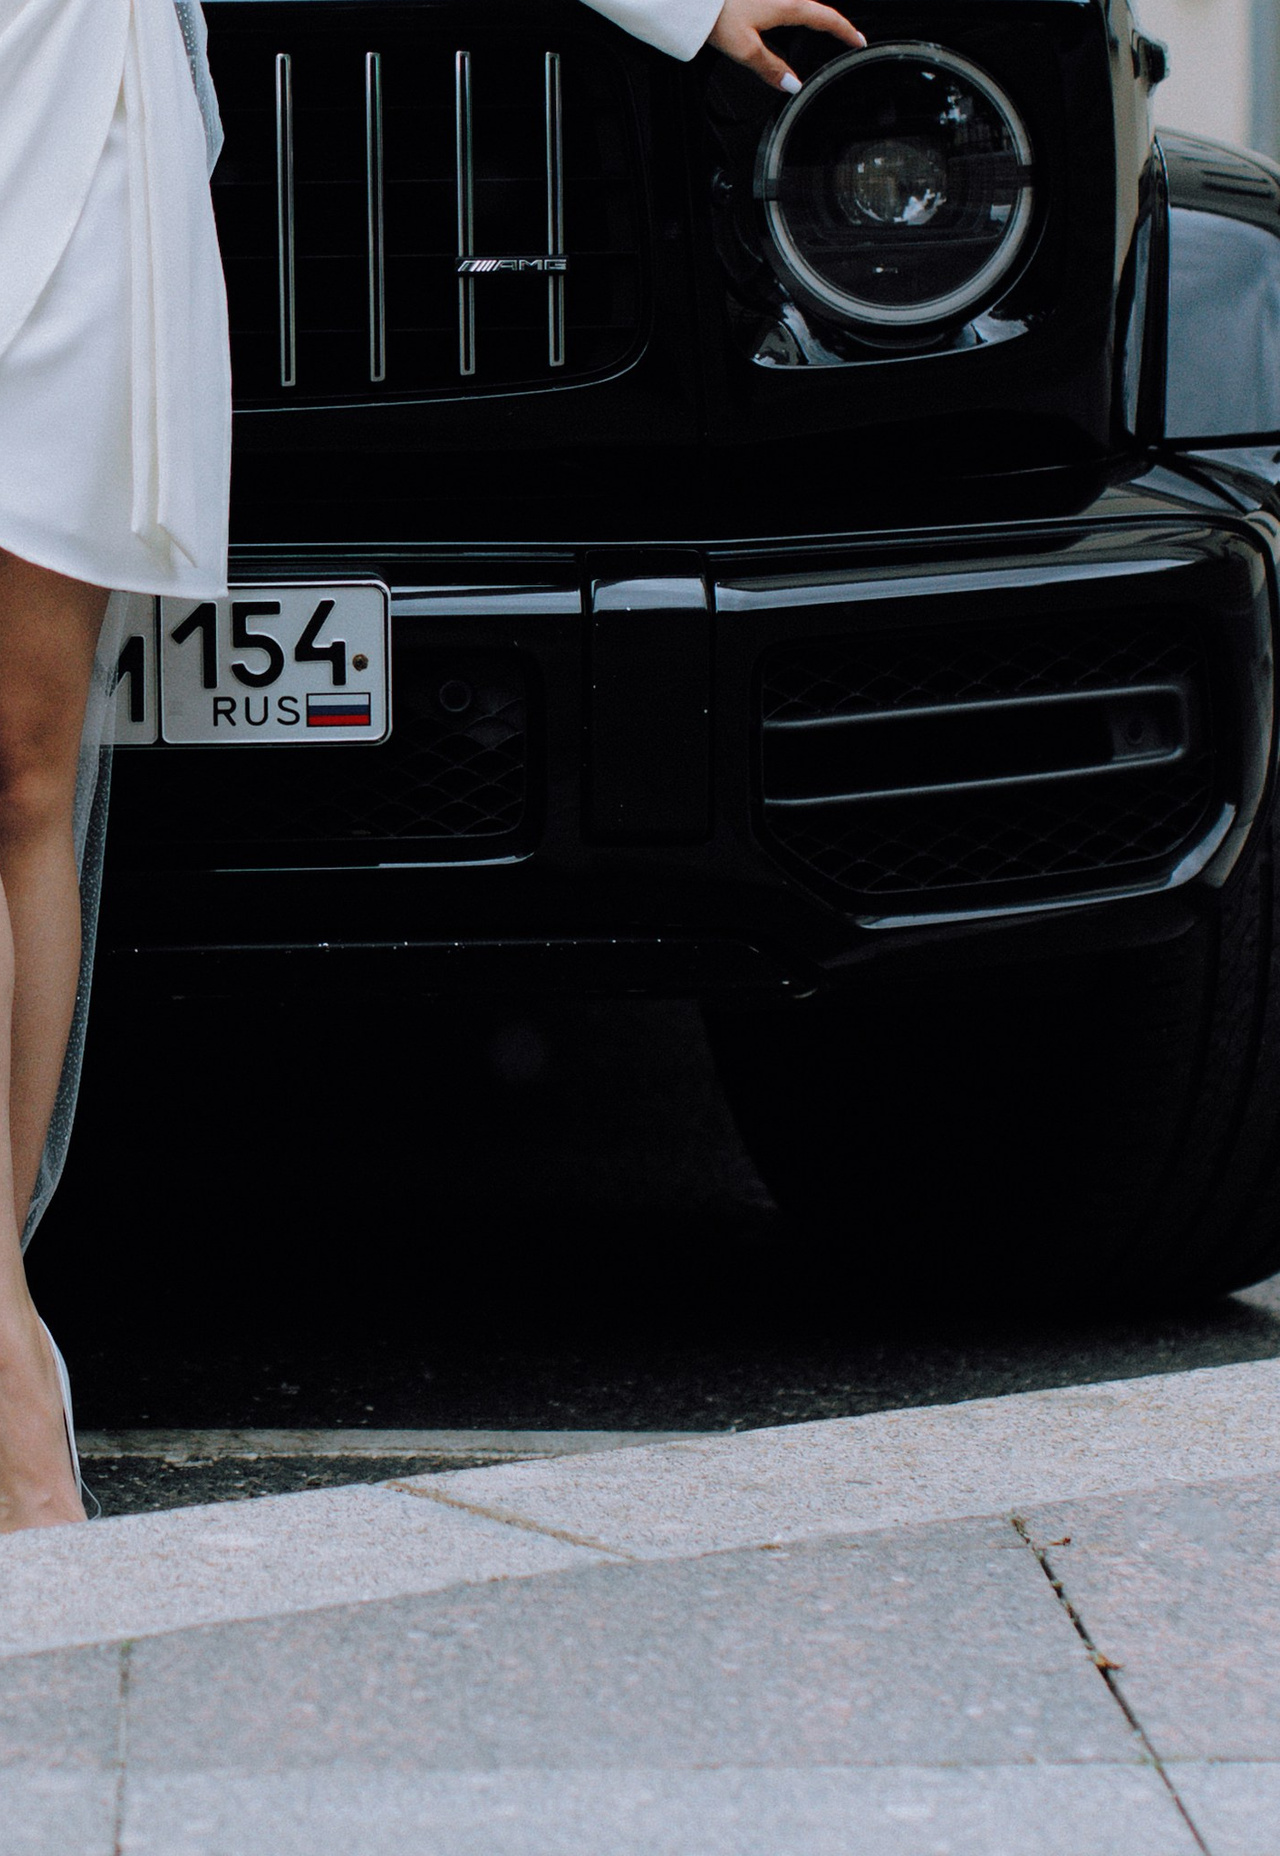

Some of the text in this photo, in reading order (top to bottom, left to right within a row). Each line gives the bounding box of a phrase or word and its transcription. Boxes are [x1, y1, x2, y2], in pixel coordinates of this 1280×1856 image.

[491, 259, 567, 271] AMG
[171, 599, 347, 689] 154
[212, 695, 301, 727] RUS
